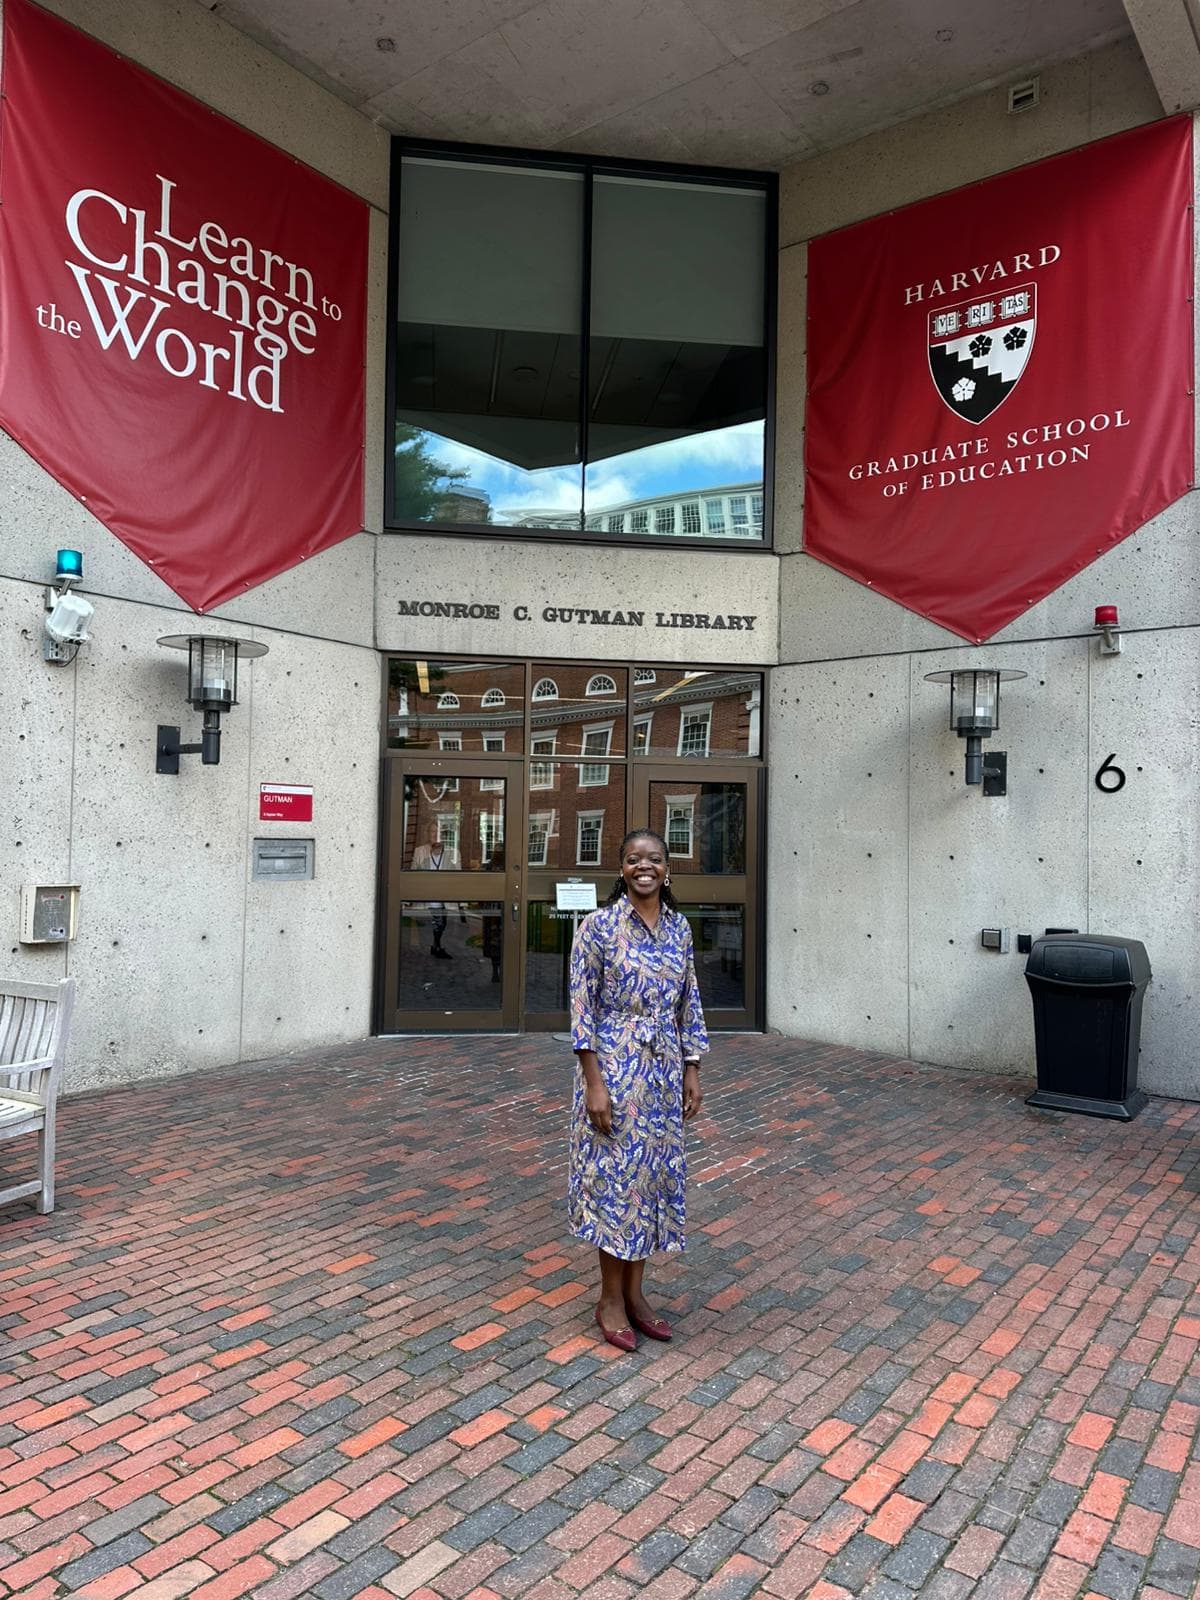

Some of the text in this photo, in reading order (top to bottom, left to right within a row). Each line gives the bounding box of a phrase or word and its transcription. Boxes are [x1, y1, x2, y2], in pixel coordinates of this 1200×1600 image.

[65, 188, 318, 361] Change
[154, 174, 343, 322] Learn to
[904, 244, 1062, 306] HARVARD
[36, 260, 285, 414] the World
[848, 409, 1131, 481] GRADUATE SCHOOL
[882, 443, 1091, 498] OF EDUCATION
[398, 600, 758, 631] MONROE C. GUTMAN LIBRARY
[263, 795, 293, 803] GUTMAN
[1094, 752, 1126, 794] 6
